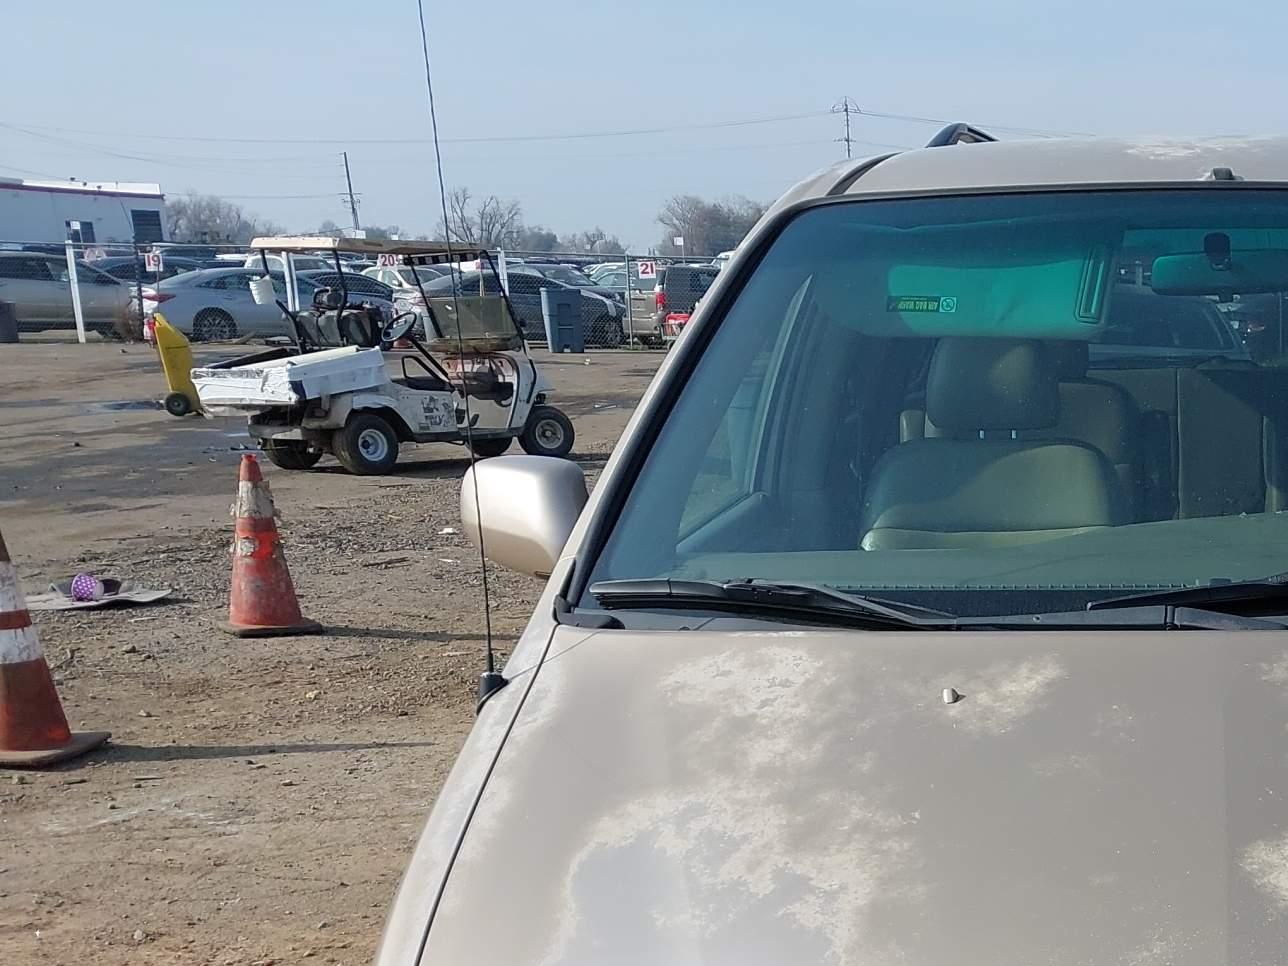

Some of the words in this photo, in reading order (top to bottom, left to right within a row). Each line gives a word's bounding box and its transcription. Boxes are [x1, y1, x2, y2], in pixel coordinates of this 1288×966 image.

[147, 254, 160, 267] 19
[381, 254, 395, 267] 20
[640, 262, 654, 275] 21
